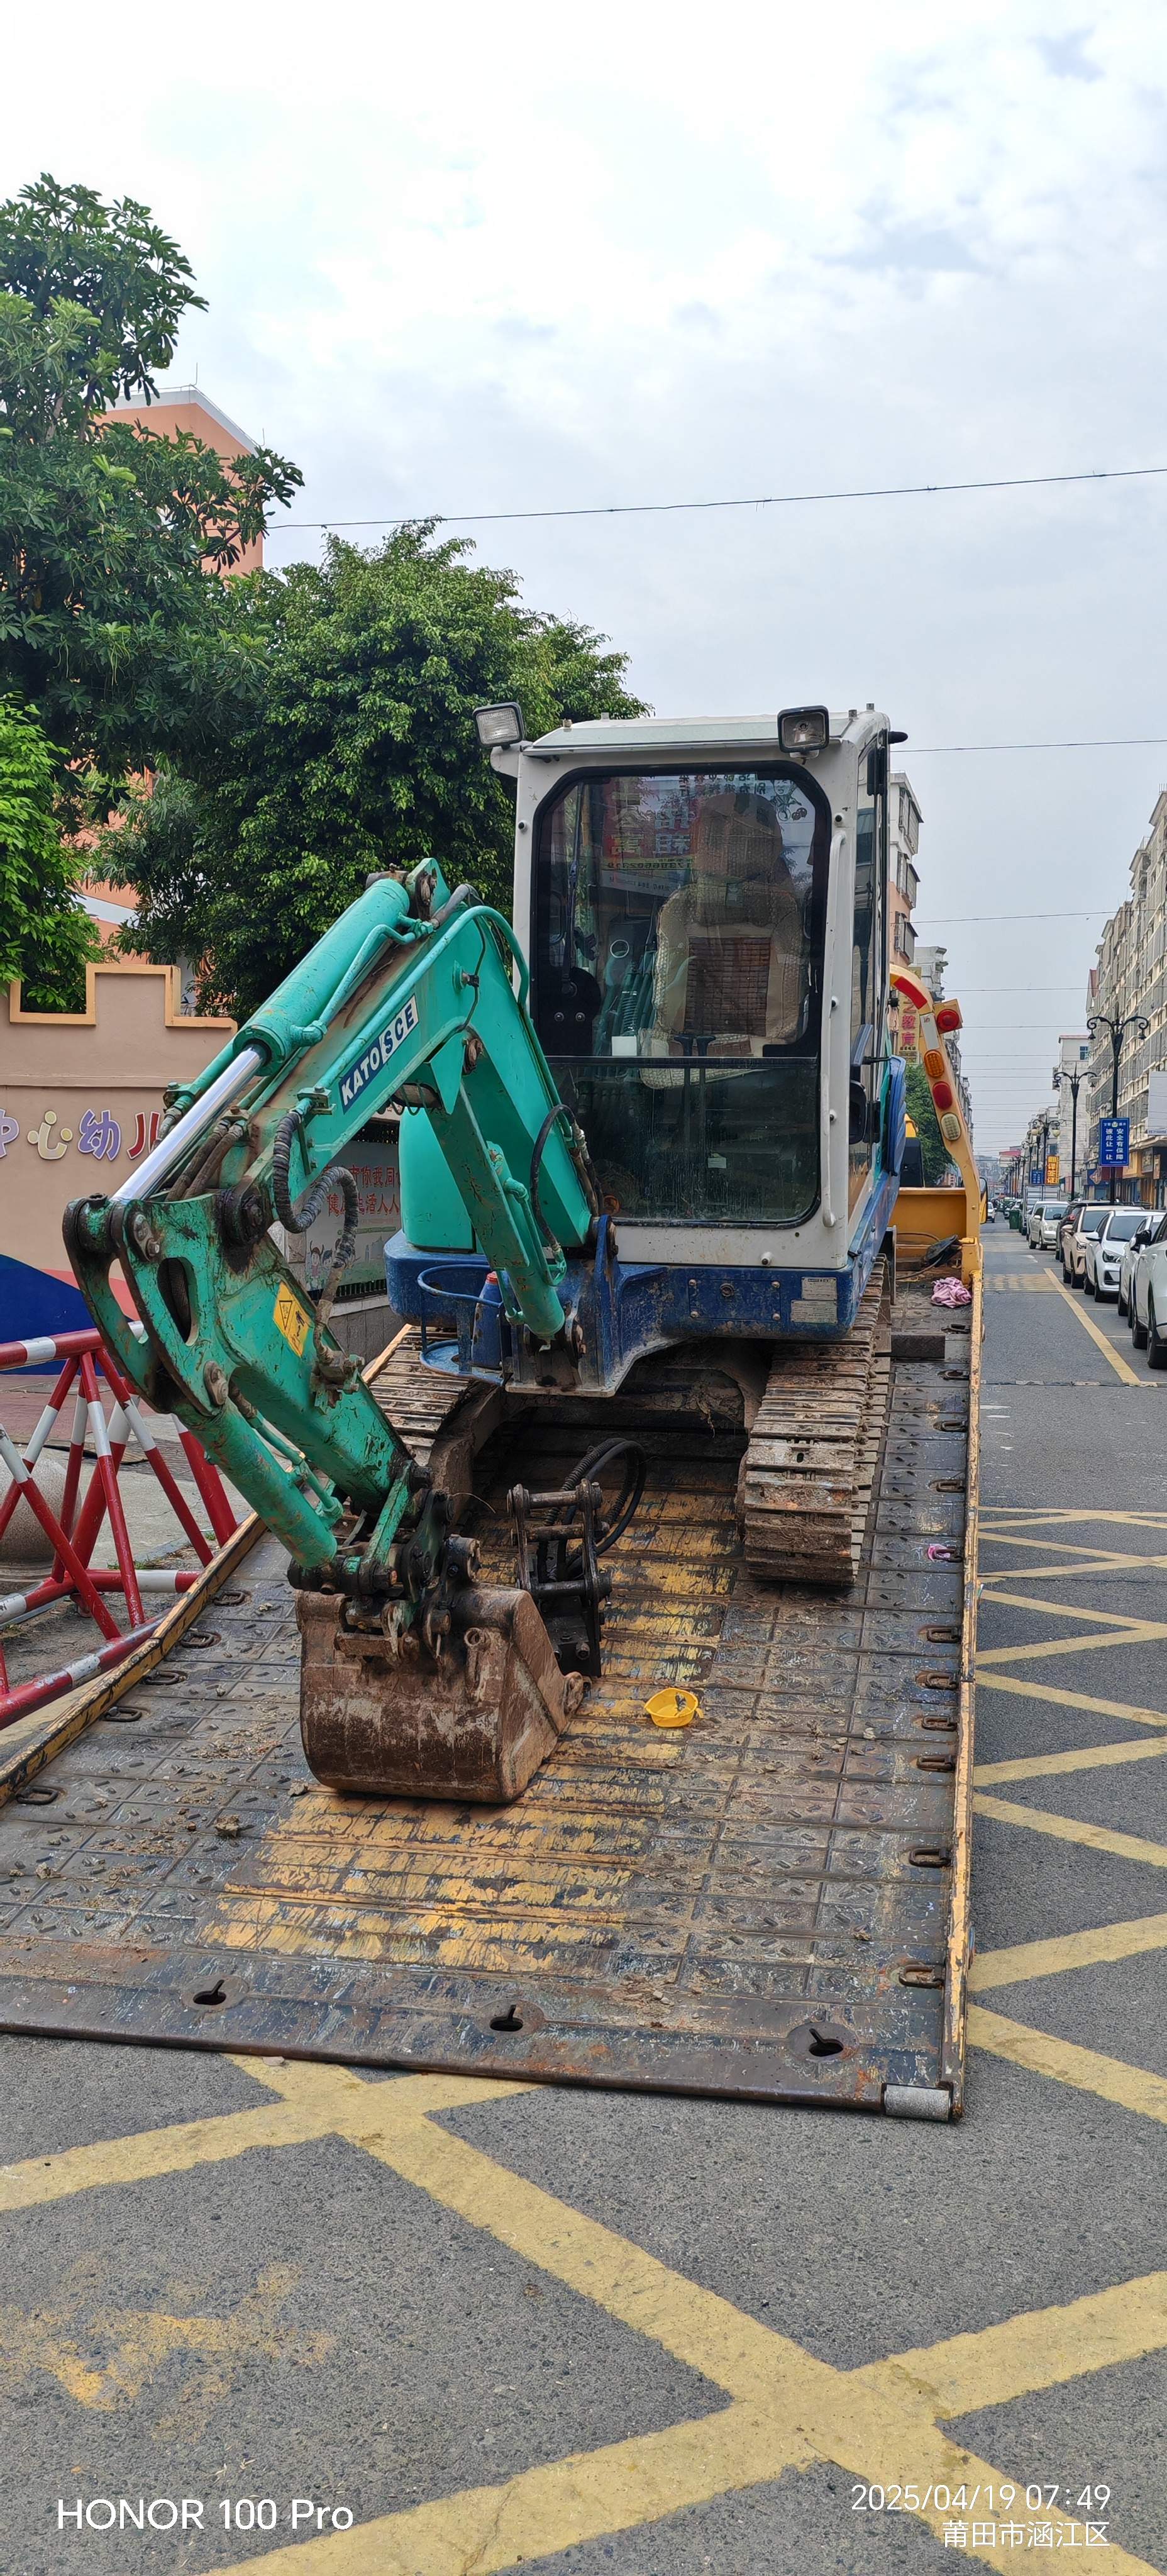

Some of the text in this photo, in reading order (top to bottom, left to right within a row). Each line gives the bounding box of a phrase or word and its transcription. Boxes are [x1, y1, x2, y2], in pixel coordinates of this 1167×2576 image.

[341, 1046, 380, 1106] KATO
[1115, 1128, 1124, 1160] 安全有保障
[326, 1192, 400, 1217] 健活人人
